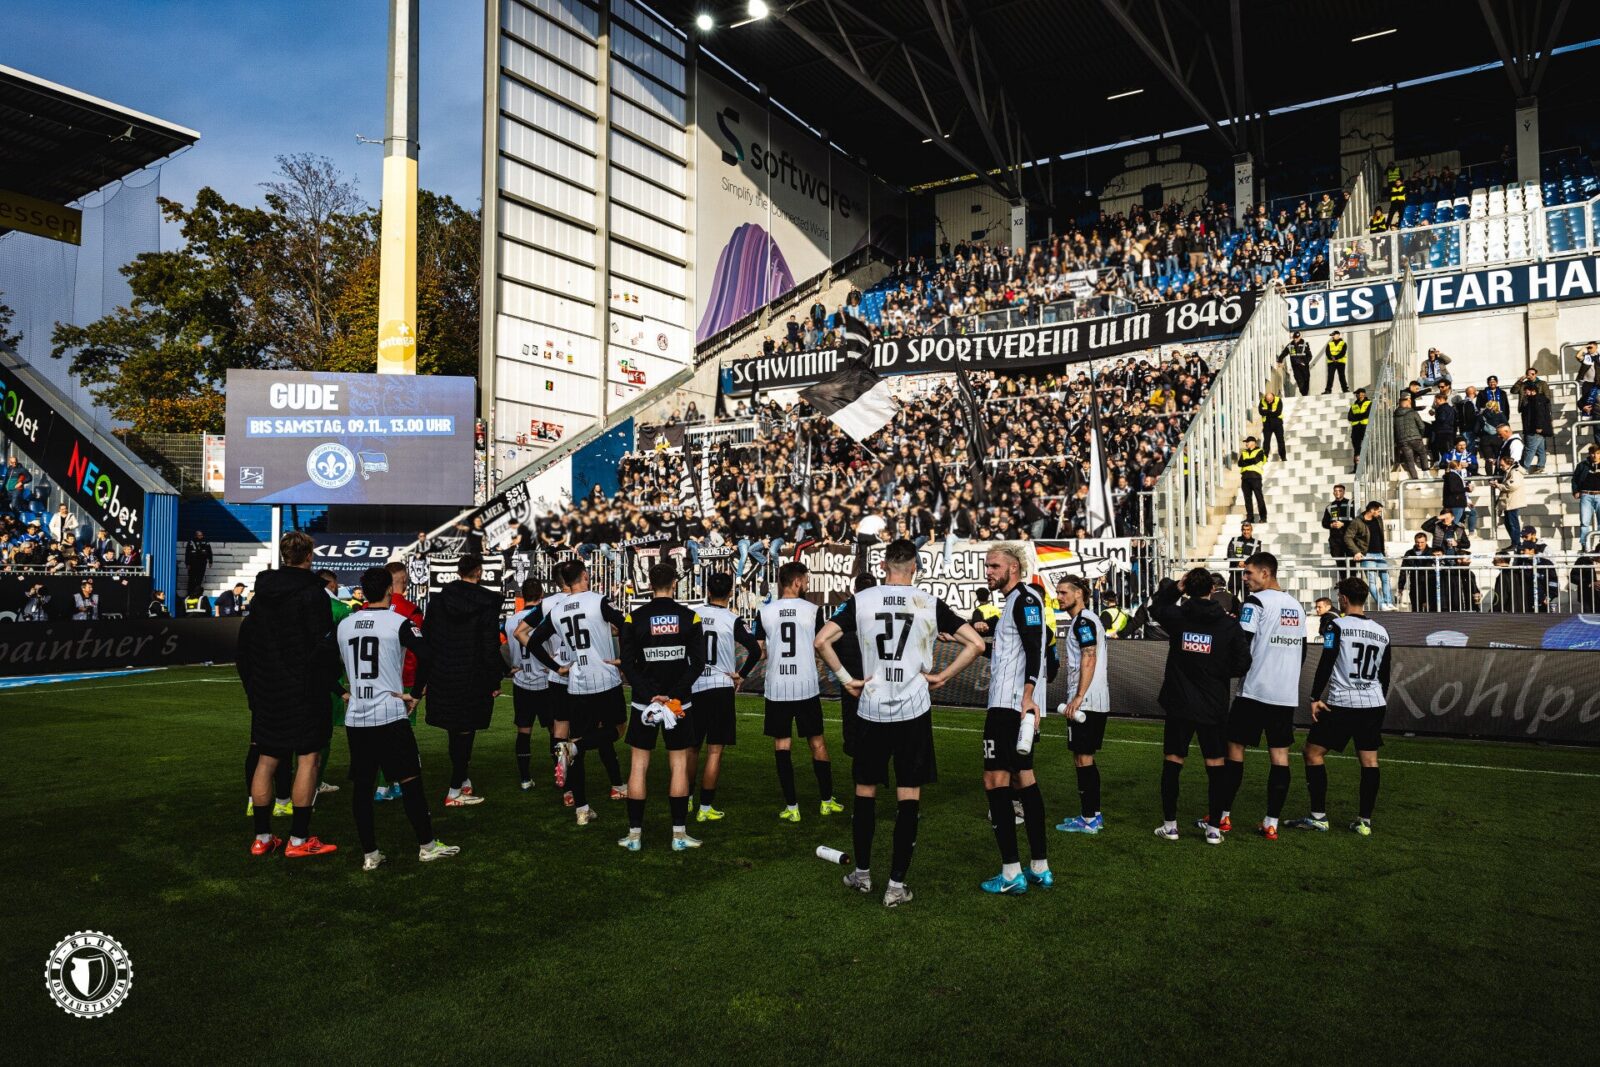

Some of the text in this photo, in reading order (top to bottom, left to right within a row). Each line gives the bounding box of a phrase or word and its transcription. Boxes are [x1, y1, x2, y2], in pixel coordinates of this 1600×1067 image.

[750, 142, 850, 219] software
[721, 176, 754, 206] Simplify
[755, 192, 768, 210] the
[772, 202, 809, 231] Connected
[1385, 269, 1514, 314] WEAR
[1529, 259, 1600, 299] HA
[906, 327, 1079, 363] SPORTVEREIN
[1089, 313, 1151, 350] ULM
[1165, 295, 1242, 334] 1846
[269, 382, 339, 410] GUDE
[250, 420, 272, 434] BIS
[275, 419, 345, 434] SAMSTAG,
[348, 420, 387, 434] 09.11.,
[426, 419, 452, 433] UHR
[505, 483, 524, 501] SSV
[507, 492, 527, 508] 1846
[564, 602, 580, 612] MAIER
[883, 596, 906, 606] KOLBE
[652, 616, 677, 625] LIQUI
[1281, 609, 1298, 618] LIQUI
[354, 620, 375, 629] MEIER
[652, 625, 677, 634] MOLY
[1281, 618, 1298, 626] MOLY
[560, 613, 591, 652] 26
[780, 622, 796, 658] 9
[875, 612, 915, 661] 27
[1184, 632, 1211, 643] LIQUI
[645, 648, 684, 660] uhlsport
[1183, 641, 1210, 653] MOLY
[348, 636, 379, 680] 19
[1349, 642, 1380, 680] 30
[779, 664, 797, 675] ULM
